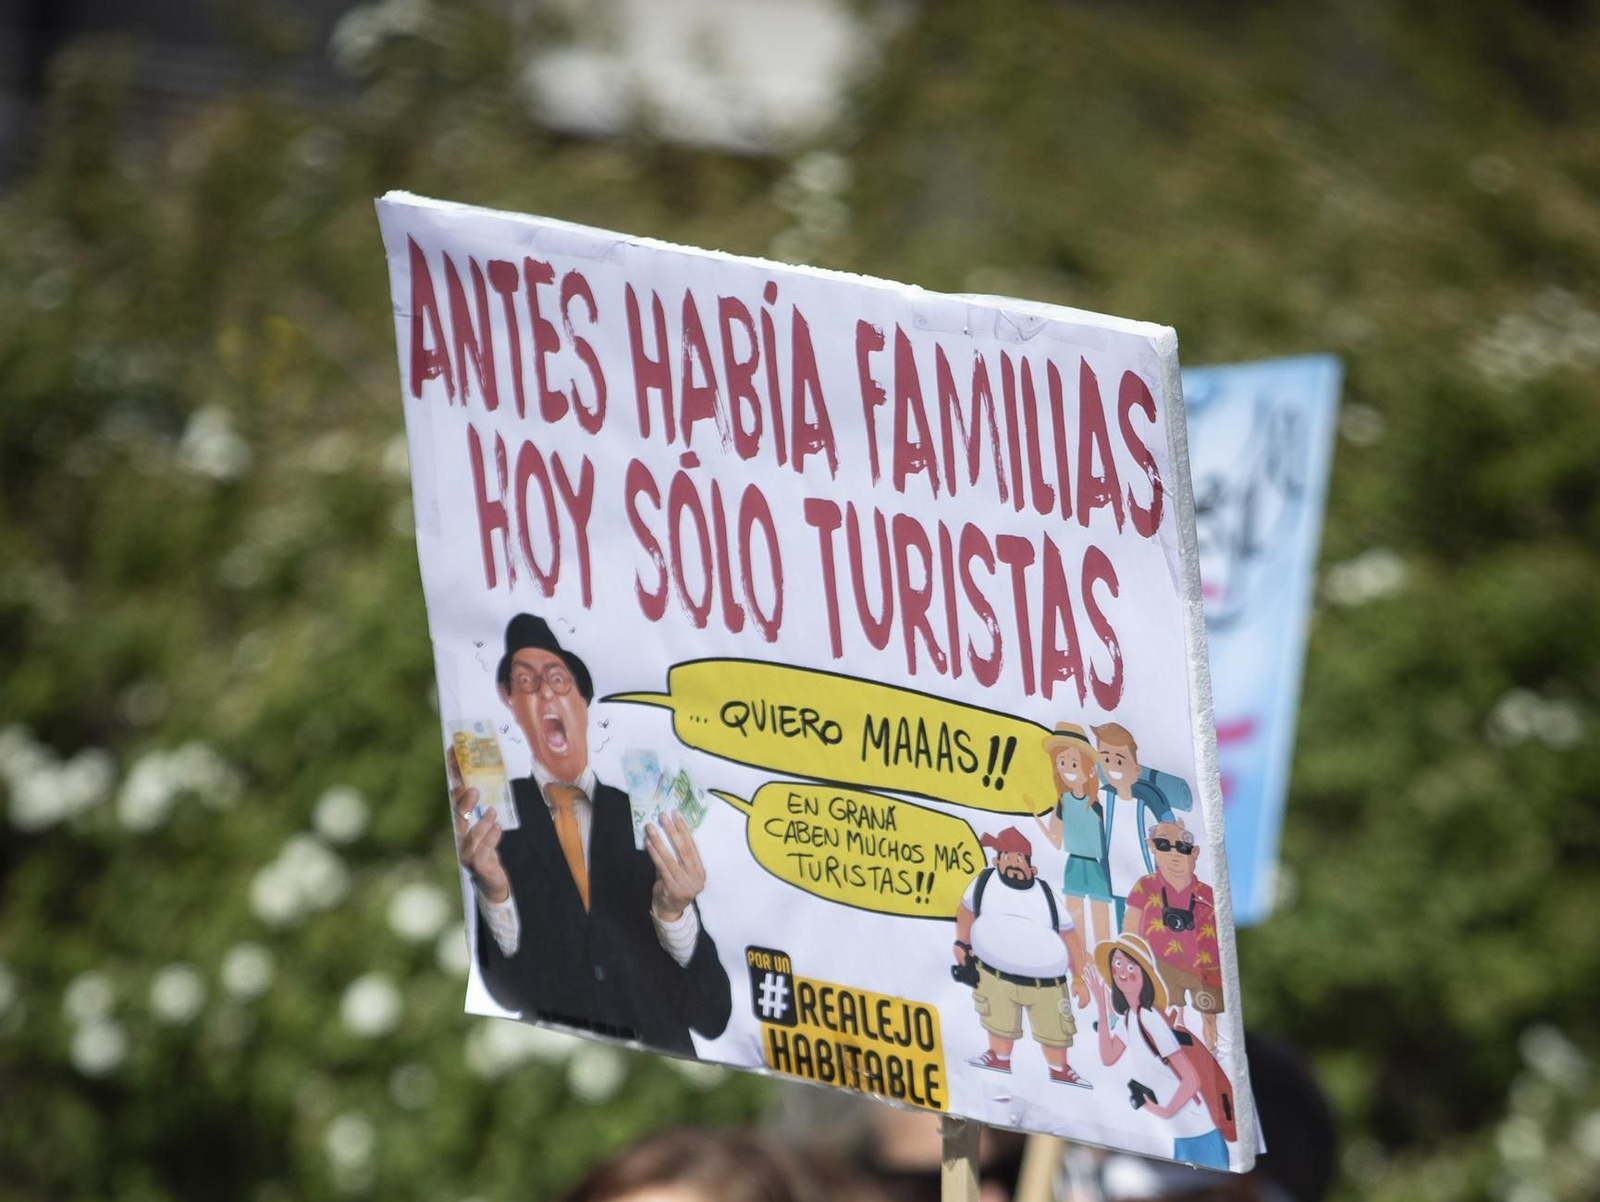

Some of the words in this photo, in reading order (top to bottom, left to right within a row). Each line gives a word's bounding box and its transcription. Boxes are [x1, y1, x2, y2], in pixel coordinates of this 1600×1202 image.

[408, 233, 608, 435] ANTES
[625, 280, 839, 482] HABÍA
[856, 318, 1164, 539] FAMILIAS
[467, 422, 594, 610] HOY
[625, 452, 784, 643] SÓLO
[804, 497, 1124, 711] TURISTAS
[719, 699, 843, 746] QUIERO
[861, 713, 1018, 791] MAAAS!!
[787, 792, 818, 816] EN
[764, 818, 839, 847] CABEN
[847, 829, 924, 864] MUCHOS
[934, 842, 975, 875] MÁS
[786, 852, 935, 904] TURISTAS!!
[747, 950, 771, 970] POR
[769, 1028, 942, 1109] HABITABLE
